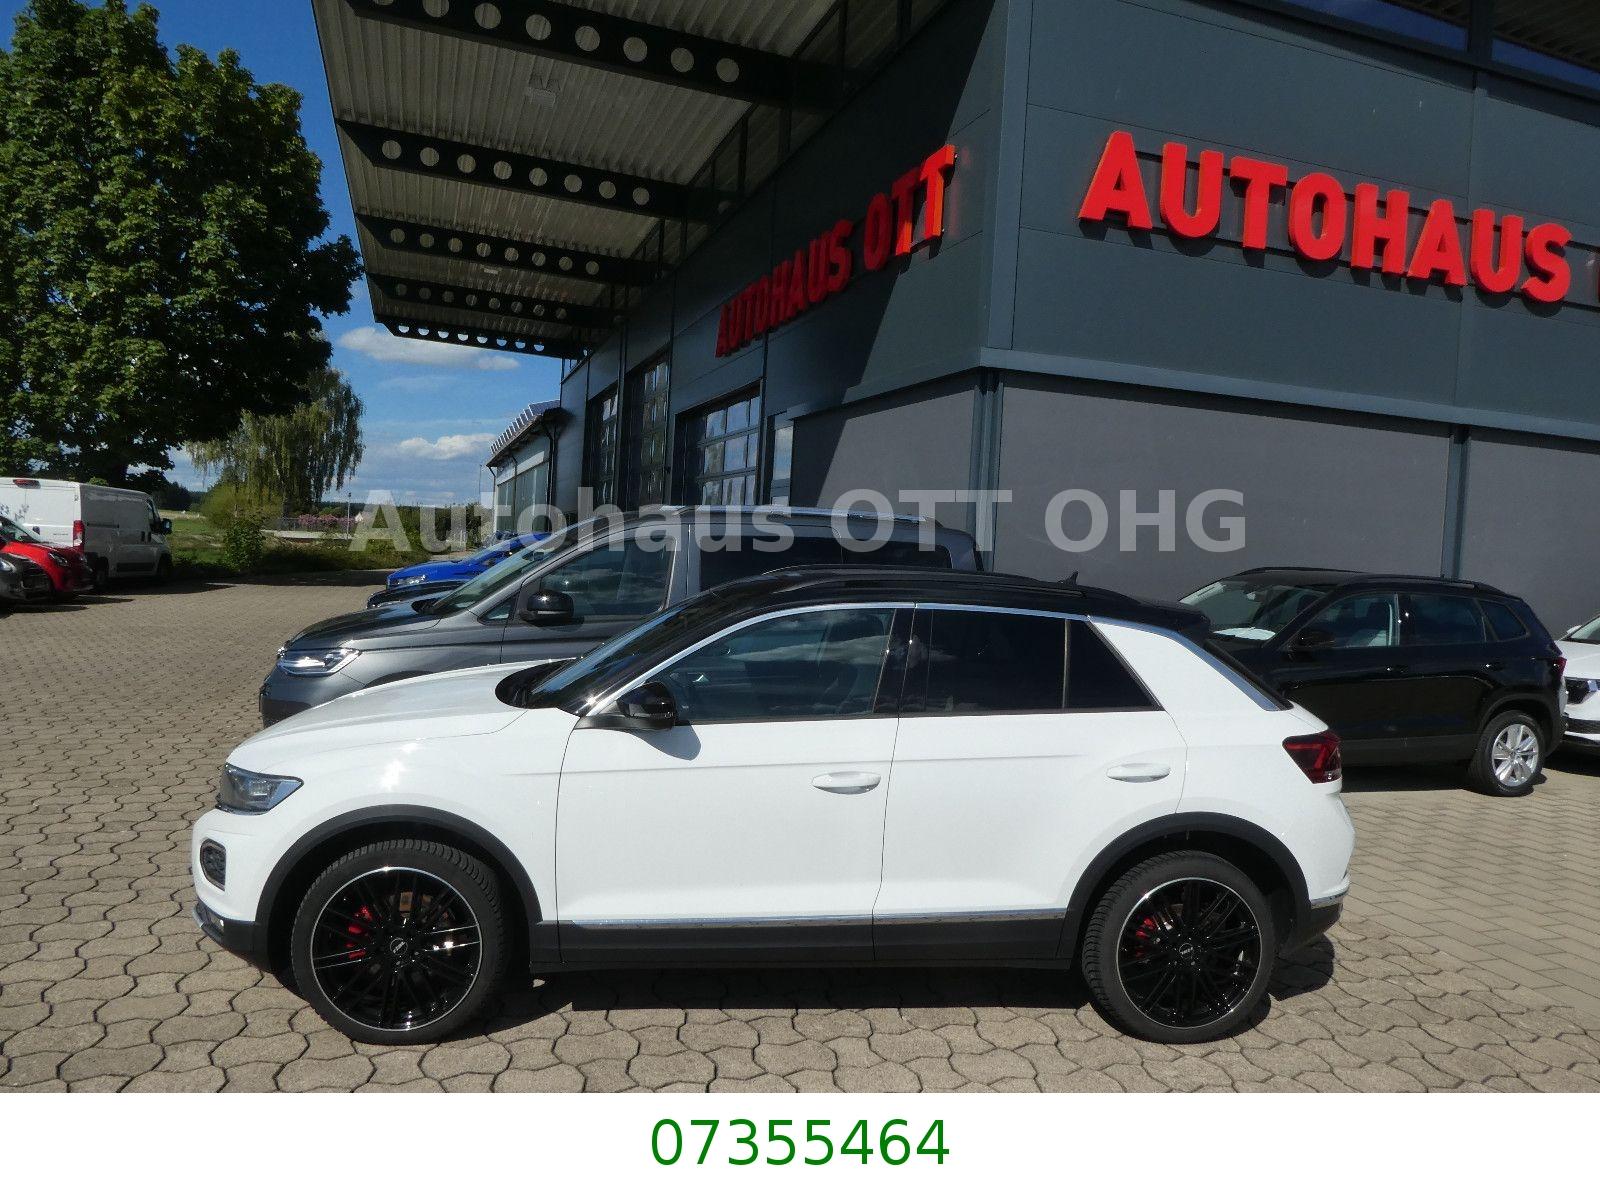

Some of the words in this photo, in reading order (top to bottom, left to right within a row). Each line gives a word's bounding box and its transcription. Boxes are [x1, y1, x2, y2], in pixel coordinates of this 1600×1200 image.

[715, 219, 853, 358] AUTOHAUS
[863, 144, 956, 271] OTT
[1078, 130, 1572, 303] AUTOHAUS
